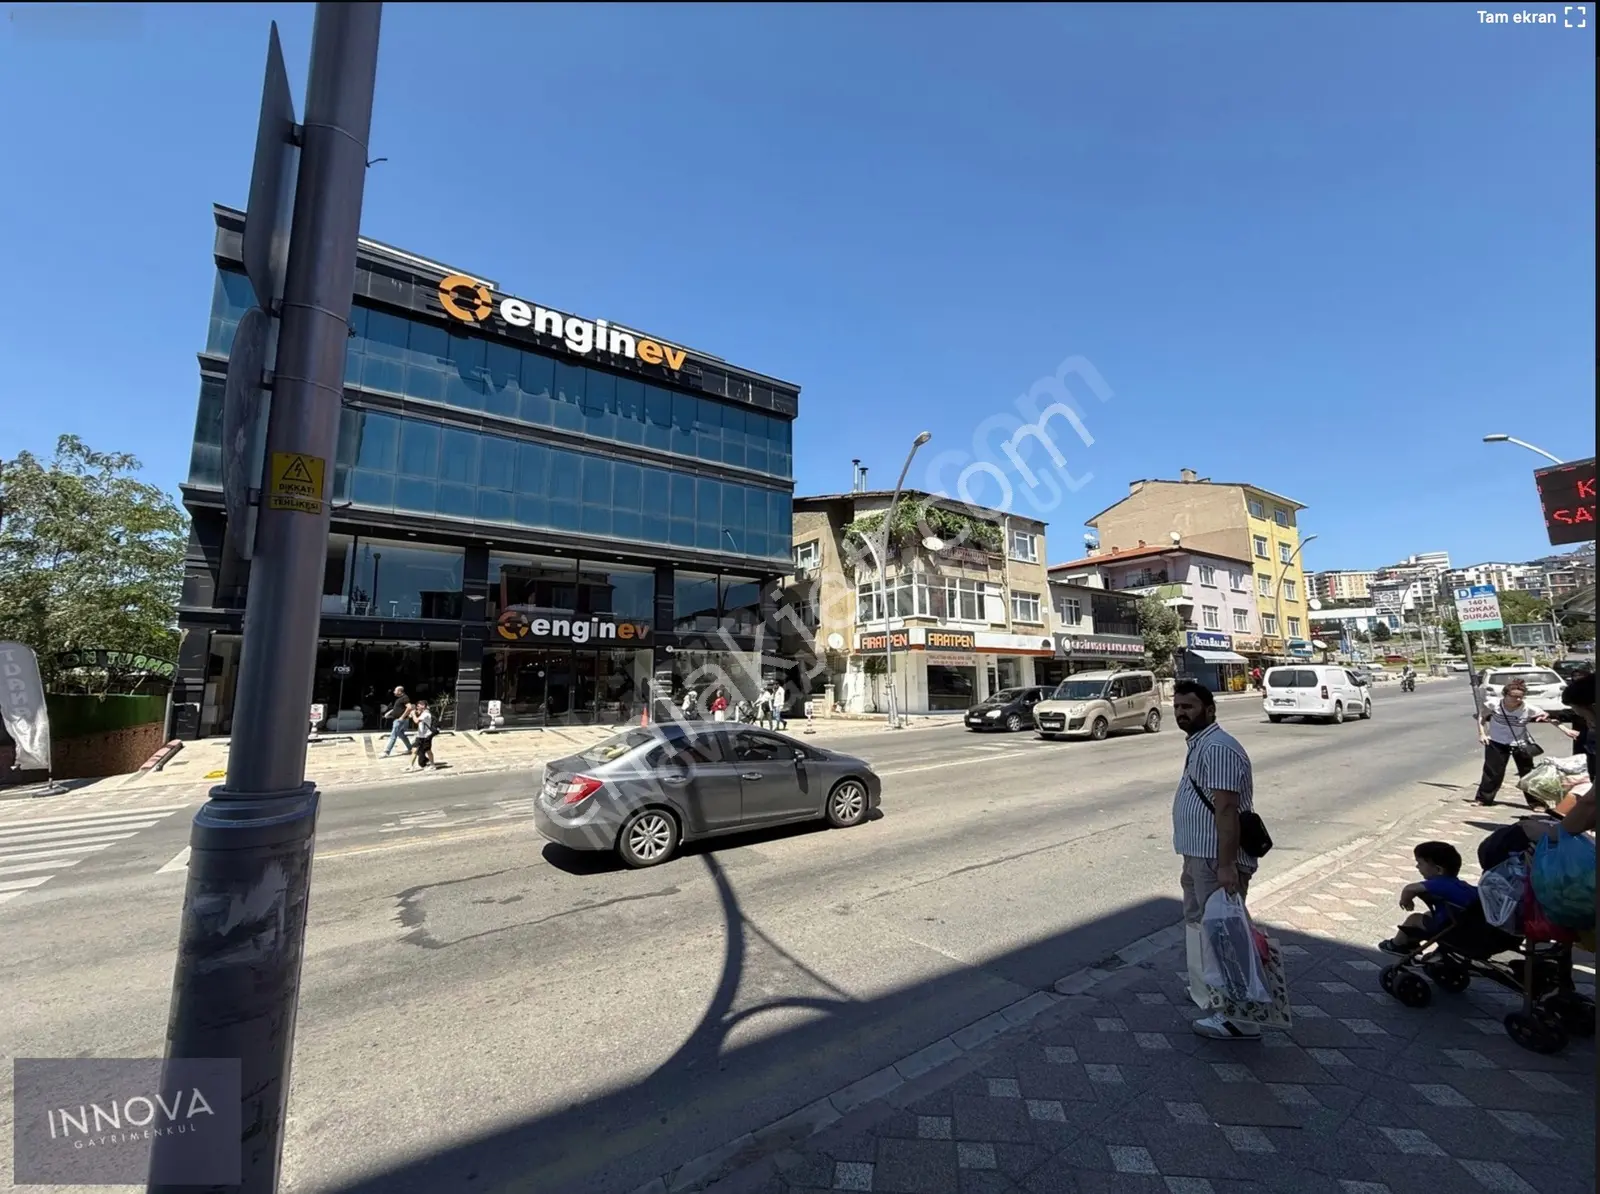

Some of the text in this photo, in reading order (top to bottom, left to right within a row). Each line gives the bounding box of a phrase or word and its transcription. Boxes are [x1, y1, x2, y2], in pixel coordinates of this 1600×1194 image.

[500, 297, 688, 371] enginev
[1553, 505, 1596, 525] SA
[1463, 604, 1496, 613] SOKAK
[530, 617, 650, 643] enginev
[928, 632, 975, 648] FIRATPEN
